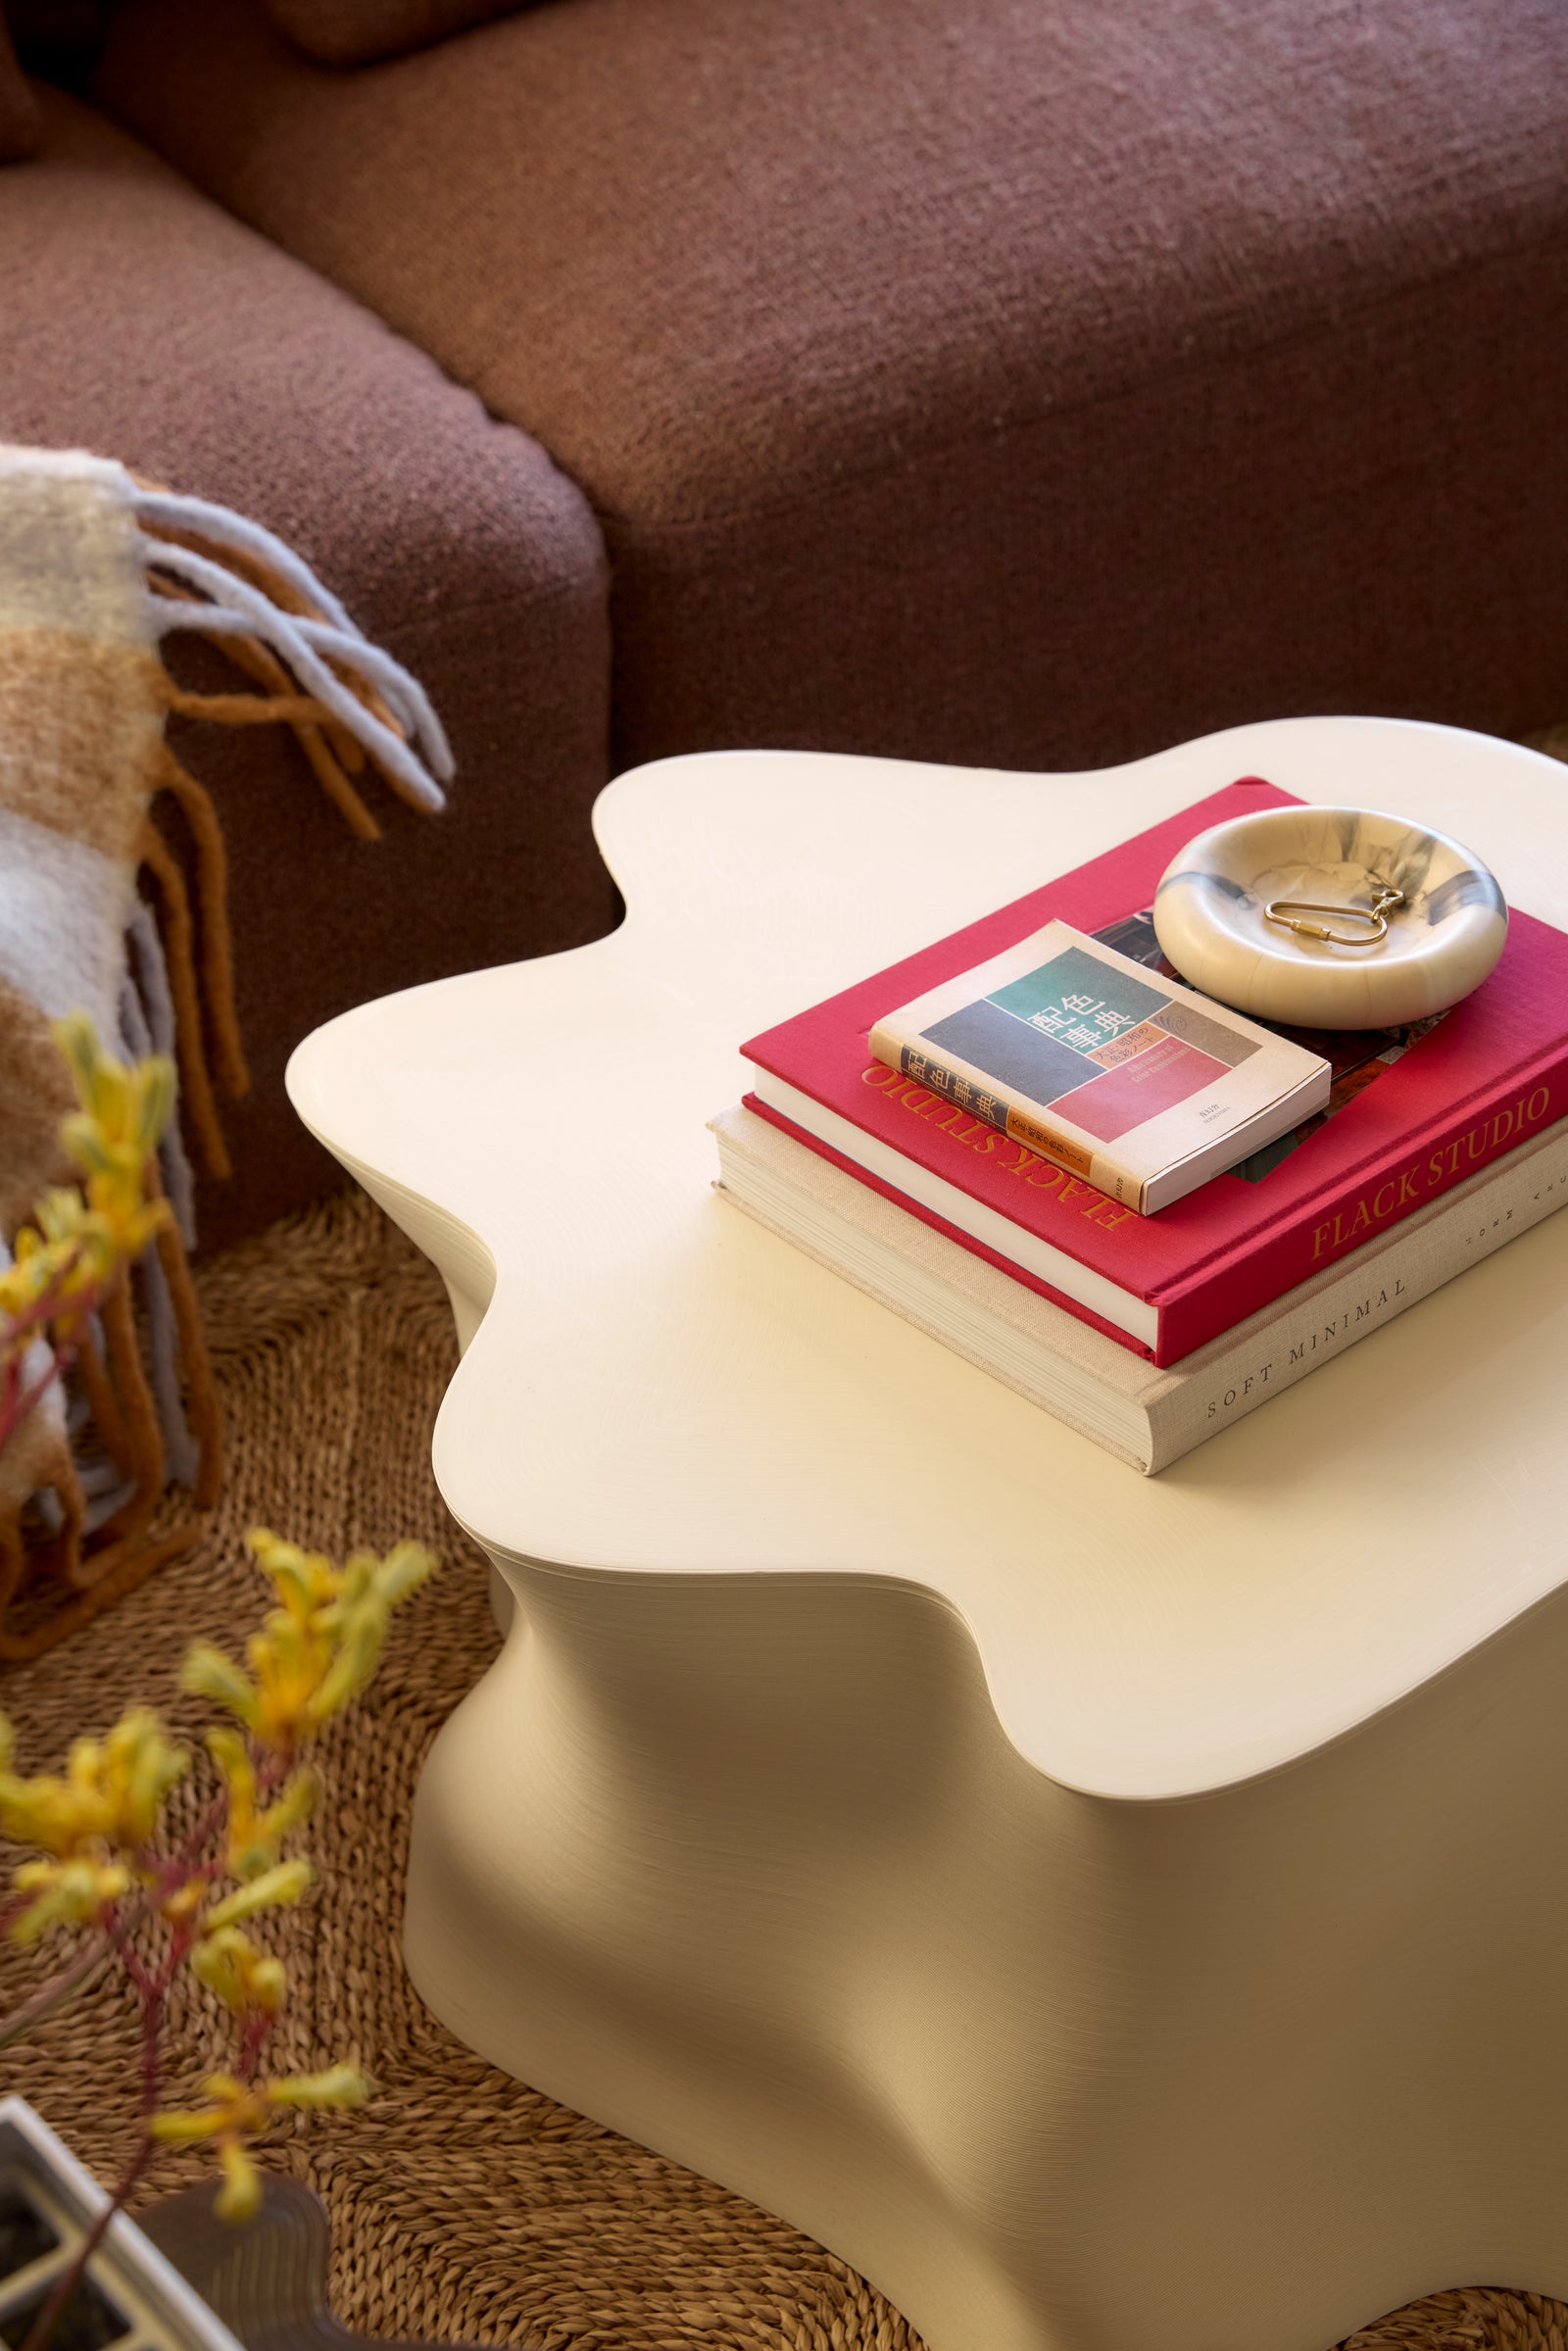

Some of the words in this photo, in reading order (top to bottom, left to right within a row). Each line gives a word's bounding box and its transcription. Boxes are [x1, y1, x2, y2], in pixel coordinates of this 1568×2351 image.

[1027, 994, 1106, 1034] 配色
[1060, 1009, 1136, 1049] 事典
[860, 1064, 1009, 1153] STUDIO
[907, 1051, 997, 1121] 配色事典
[997, 1149, 1138, 1231] FLACK
[1311, 1168, 1420, 1260] FLACK
[1427, 1087, 1549, 1187] STUDIO
[1206, 1363, 1272, 1419] SOFT
[1289, 1278, 1405, 1365] MINIMAL
